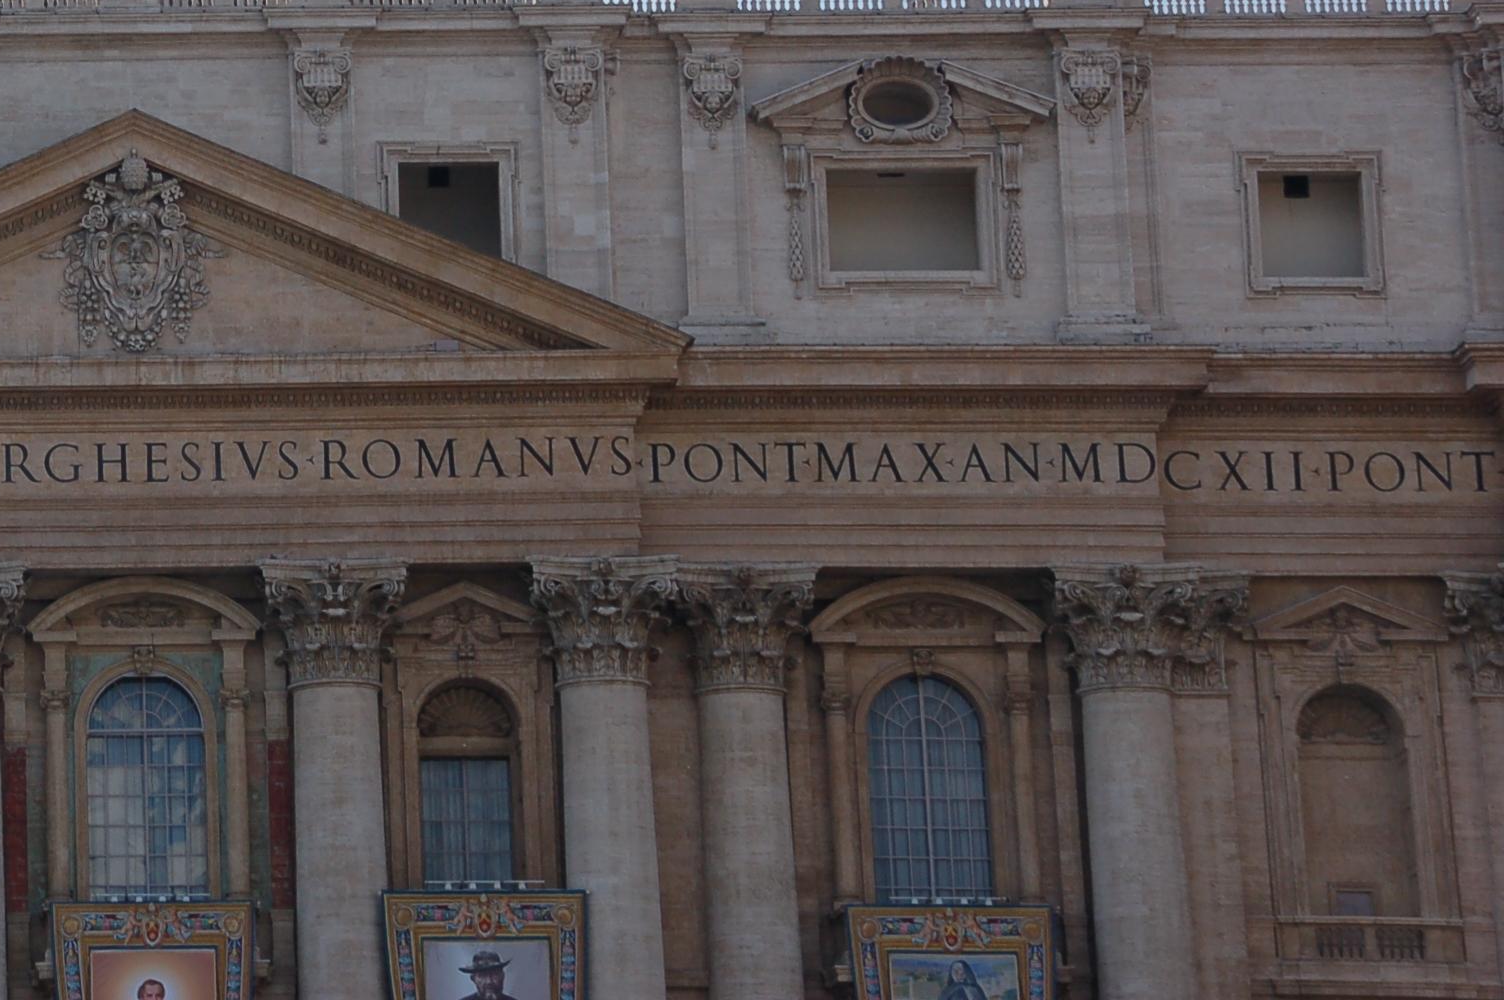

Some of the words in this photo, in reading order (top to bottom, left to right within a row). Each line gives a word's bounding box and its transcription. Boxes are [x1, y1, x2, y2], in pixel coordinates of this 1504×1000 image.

[319, 435, 633, 481] ROMANVS
[648, 441, 807, 484] PONT
[813, 441, 950, 483] MAX
[957, 441, 1041, 483] AN
[1325, 450, 1495, 492] PONT
